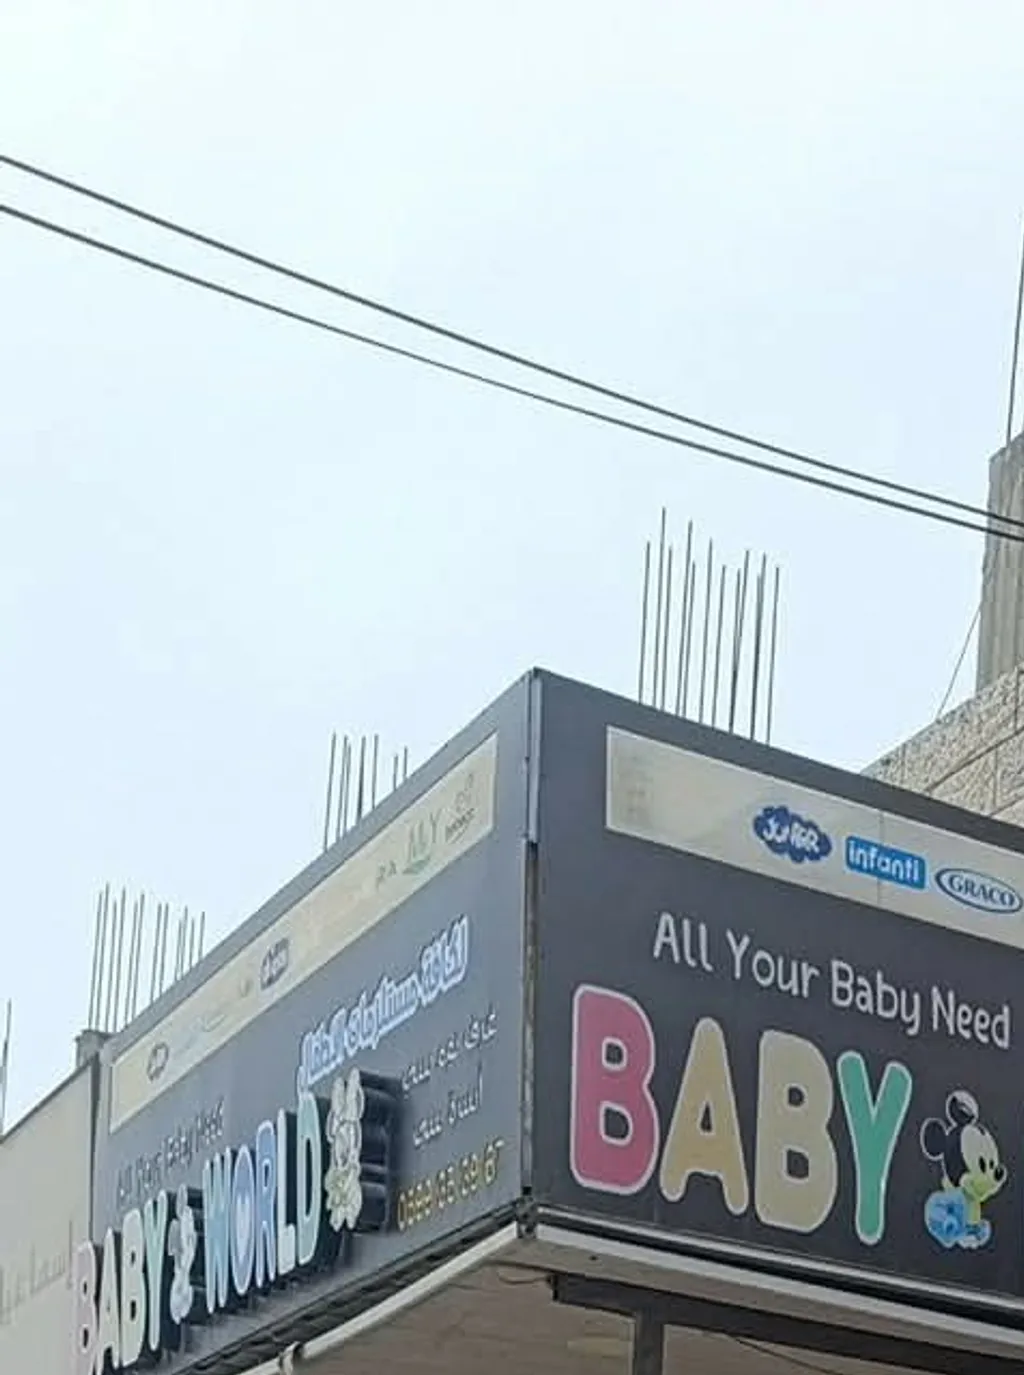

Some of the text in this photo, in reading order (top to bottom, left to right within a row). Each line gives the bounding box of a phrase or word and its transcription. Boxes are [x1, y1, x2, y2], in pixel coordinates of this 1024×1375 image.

[848, 840, 923, 882] infanti
[948, 876, 1016, 907] GRACO
[652, 911, 1011, 1049] All Your Baby Need
[570, 983, 914, 1246] BABY
[202, 1089, 323, 1315] WORLD
